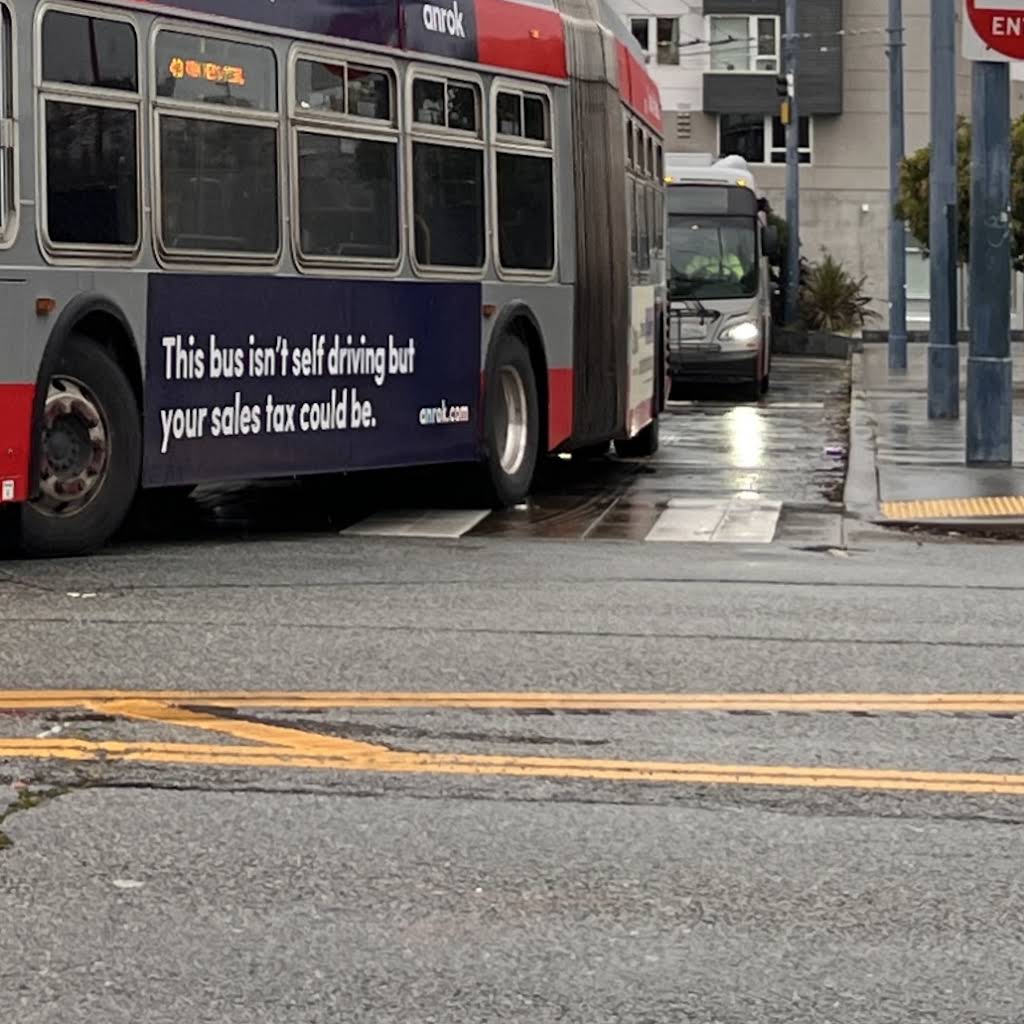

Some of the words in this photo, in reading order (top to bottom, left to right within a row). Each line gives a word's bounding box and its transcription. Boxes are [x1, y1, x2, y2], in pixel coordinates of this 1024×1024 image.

[422, 0, 465, 38] anrok
[992, 16, 1024, 36] EN
[162, 334, 205, 380] This
[209, 334, 244, 378] bus
[248, 334, 289, 377] isn't
[292, 333, 326, 376] self
[328, 333, 386, 386] driving
[388, 334, 416, 375] but
[160, 407, 208, 454] your
[210, 391, 262, 437] sales
[265, 394, 296, 433] tax
[299, 387, 348, 431] could
[350, 387, 377, 429] be.
[418, 398, 470, 425] anrok.com
